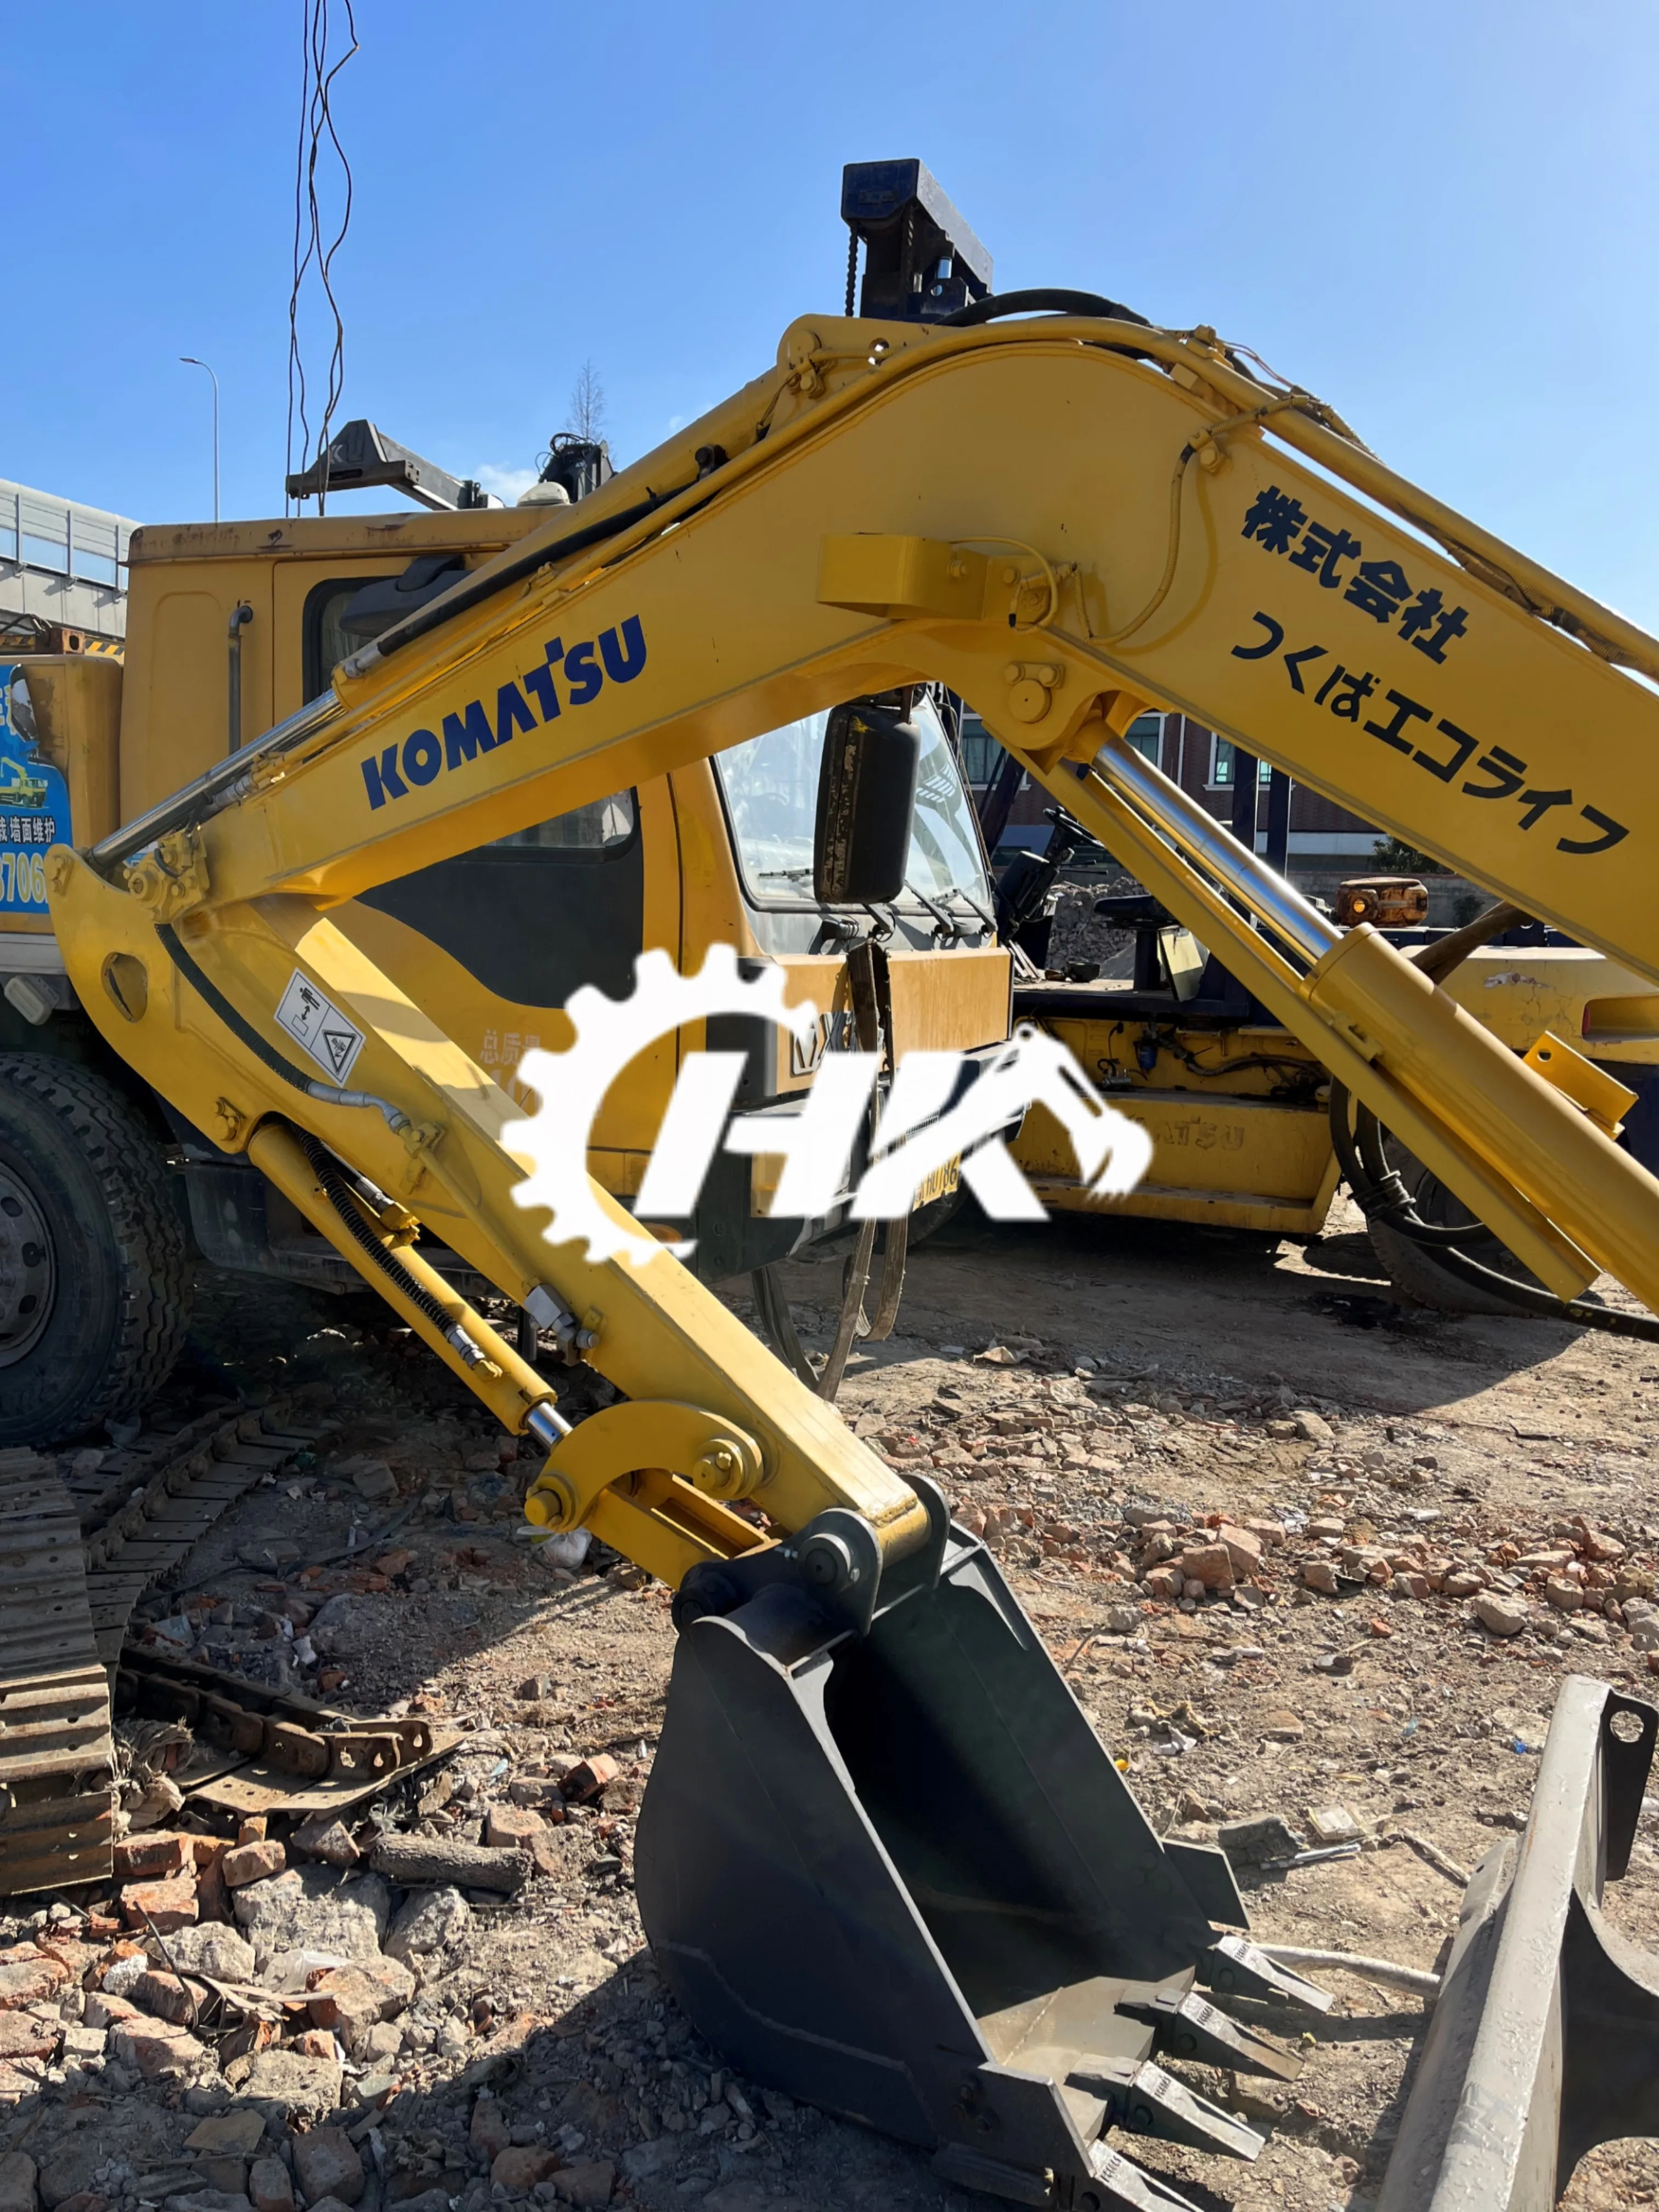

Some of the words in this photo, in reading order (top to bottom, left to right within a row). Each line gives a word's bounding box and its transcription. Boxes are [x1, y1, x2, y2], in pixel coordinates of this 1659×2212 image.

[1240, 484, 1470, 665] 株式会社
[360, 614, 647, 811] KOMATSU
[1230, 611, 1630, 855] つくばエコライフ
[0, 852, 49, 904] 706
[9, 816, 55, 843] 墙面维护
